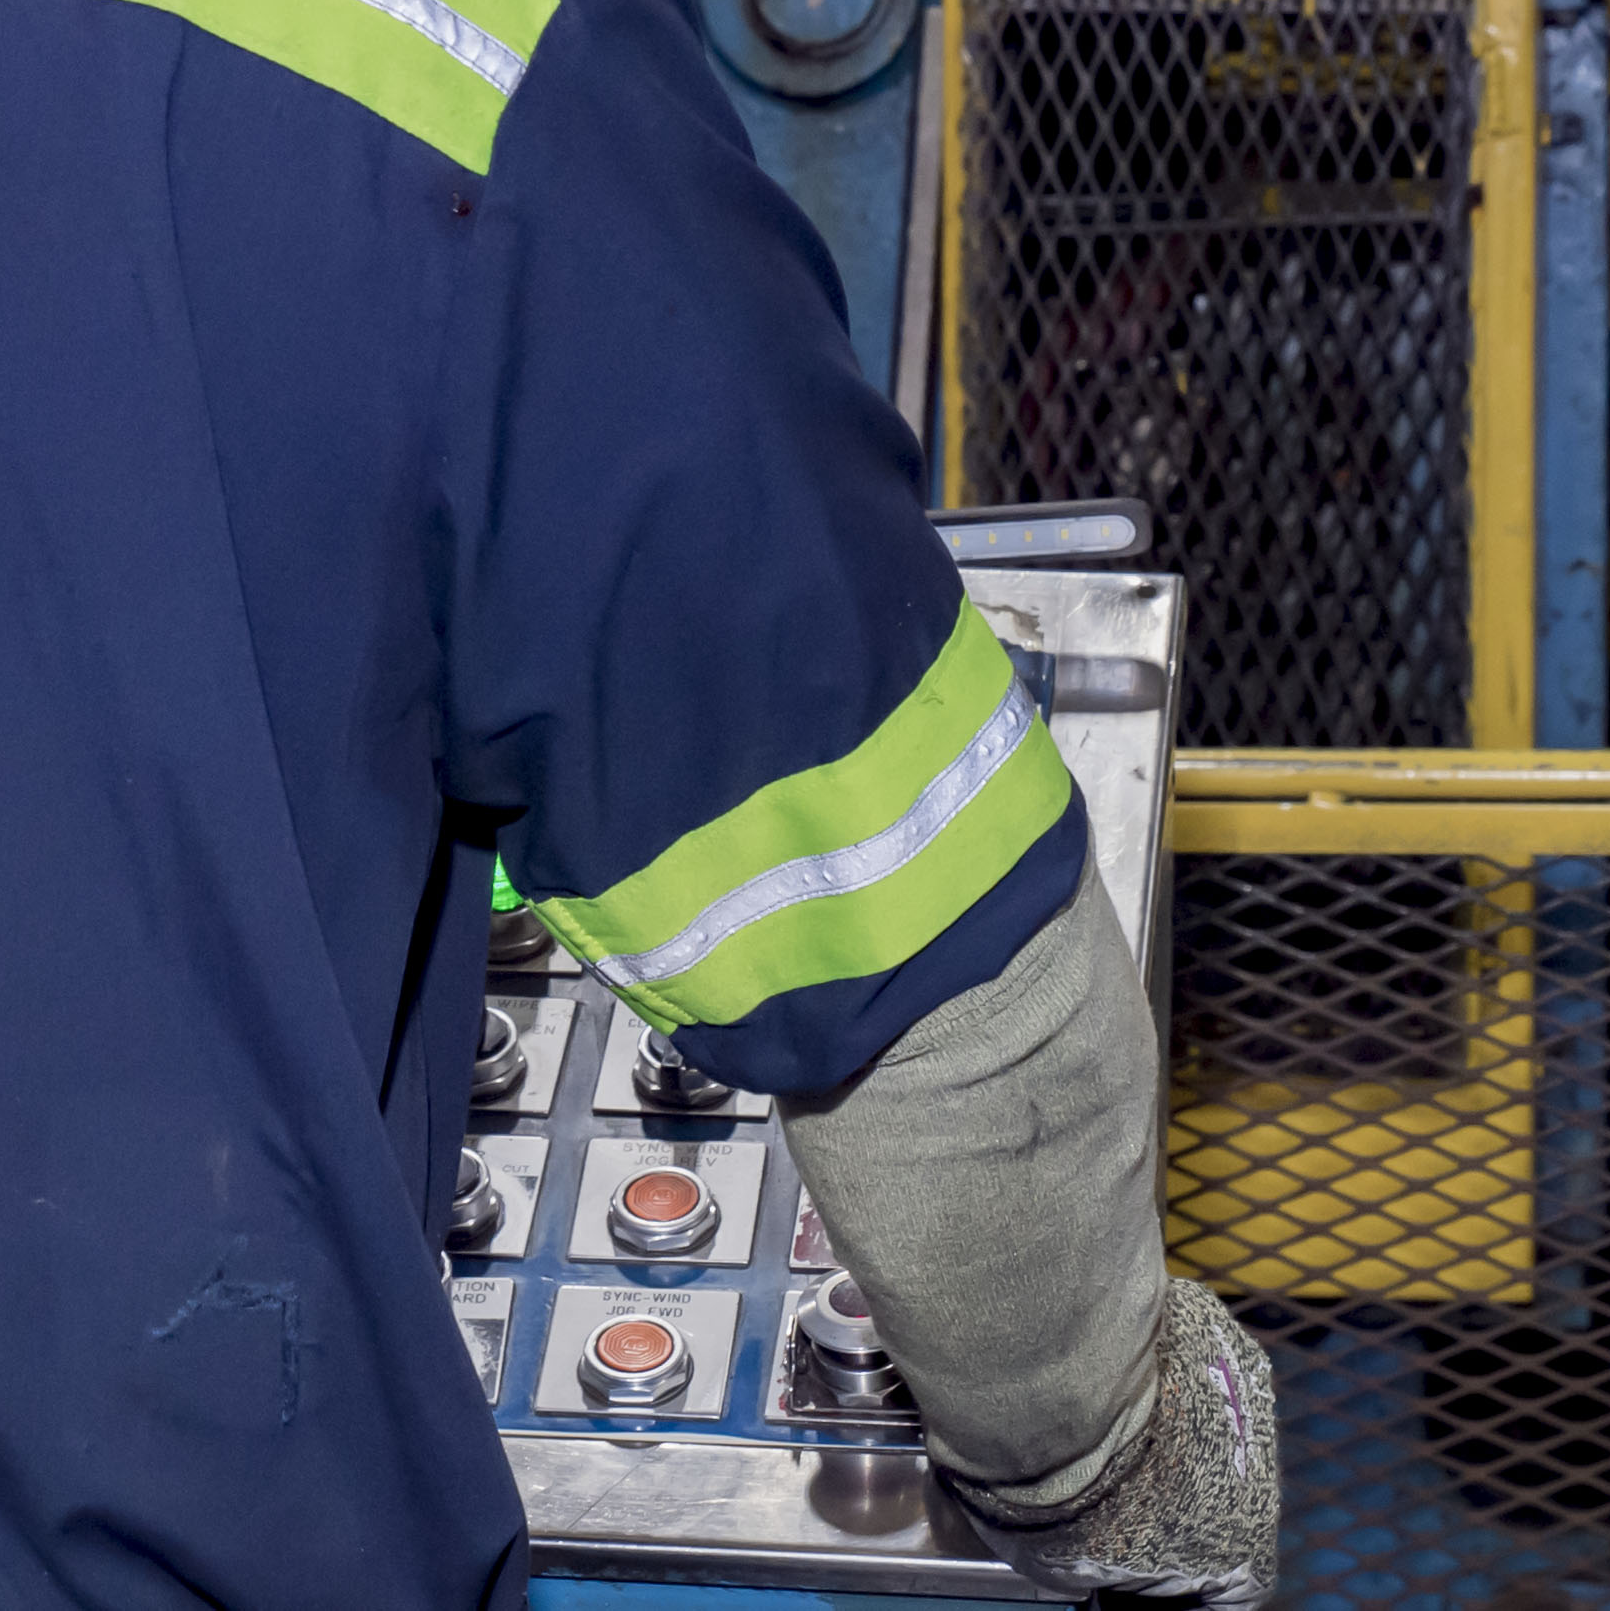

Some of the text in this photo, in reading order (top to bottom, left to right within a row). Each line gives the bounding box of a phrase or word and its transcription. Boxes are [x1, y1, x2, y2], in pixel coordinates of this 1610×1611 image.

[623, 1141, 734, 1156] SYNC-WIND
[634, 1155, 719, 1168] JOG REV
[501, 1164, 531, 1174] CUT
[455, 1281, 496, 1293] TION
[452, 1293, 487, 1304] ARD
[602, 1290, 692, 1305] SYNC-WIND
[606, 1305, 684, 1319] JOG FWD
